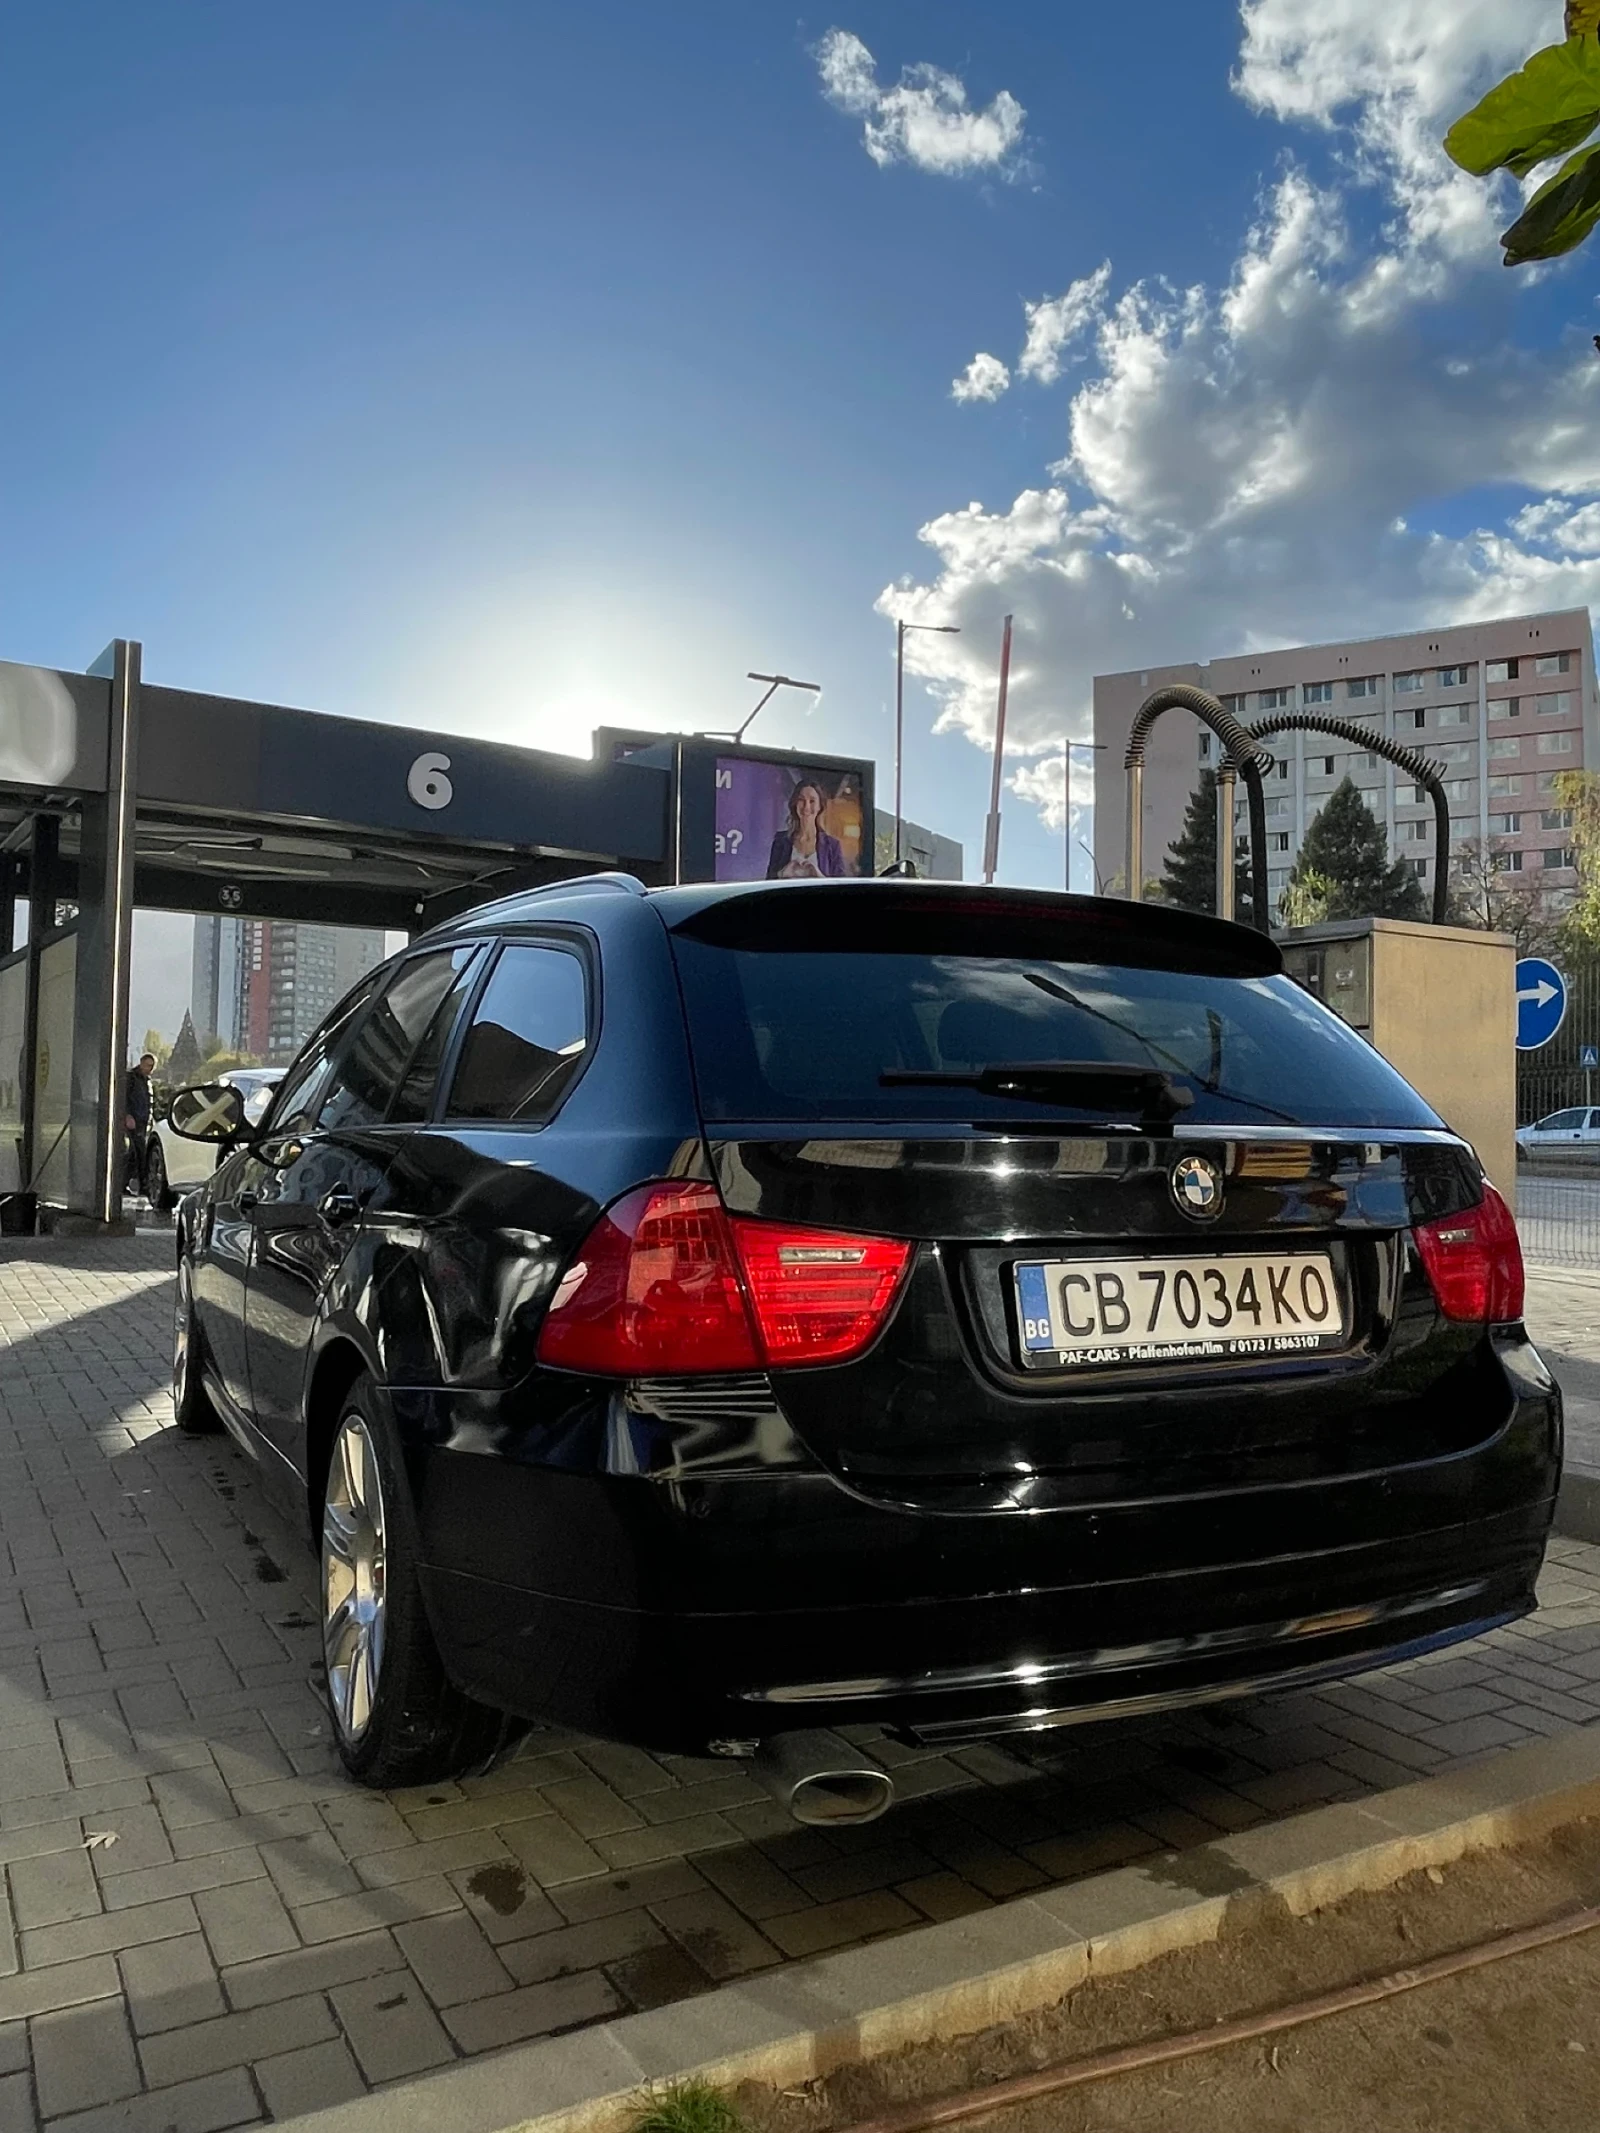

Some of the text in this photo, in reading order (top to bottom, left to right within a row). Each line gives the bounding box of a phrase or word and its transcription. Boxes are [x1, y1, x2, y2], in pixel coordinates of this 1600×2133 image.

[407, 752, 453, 810] 6
[1177, 1158, 1216, 1177] BMW
[1059, 1272, 1131, 1336] CB
[1138, 1267, 1261, 1332] 7034
[1025, 1318, 1050, 1340] BG
[1059, 1348, 1121, 1364] PAF-CARS
[1238, 1339, 1265, 1352] 0173
[1274, 1335, 1320, 1350] 5863107
